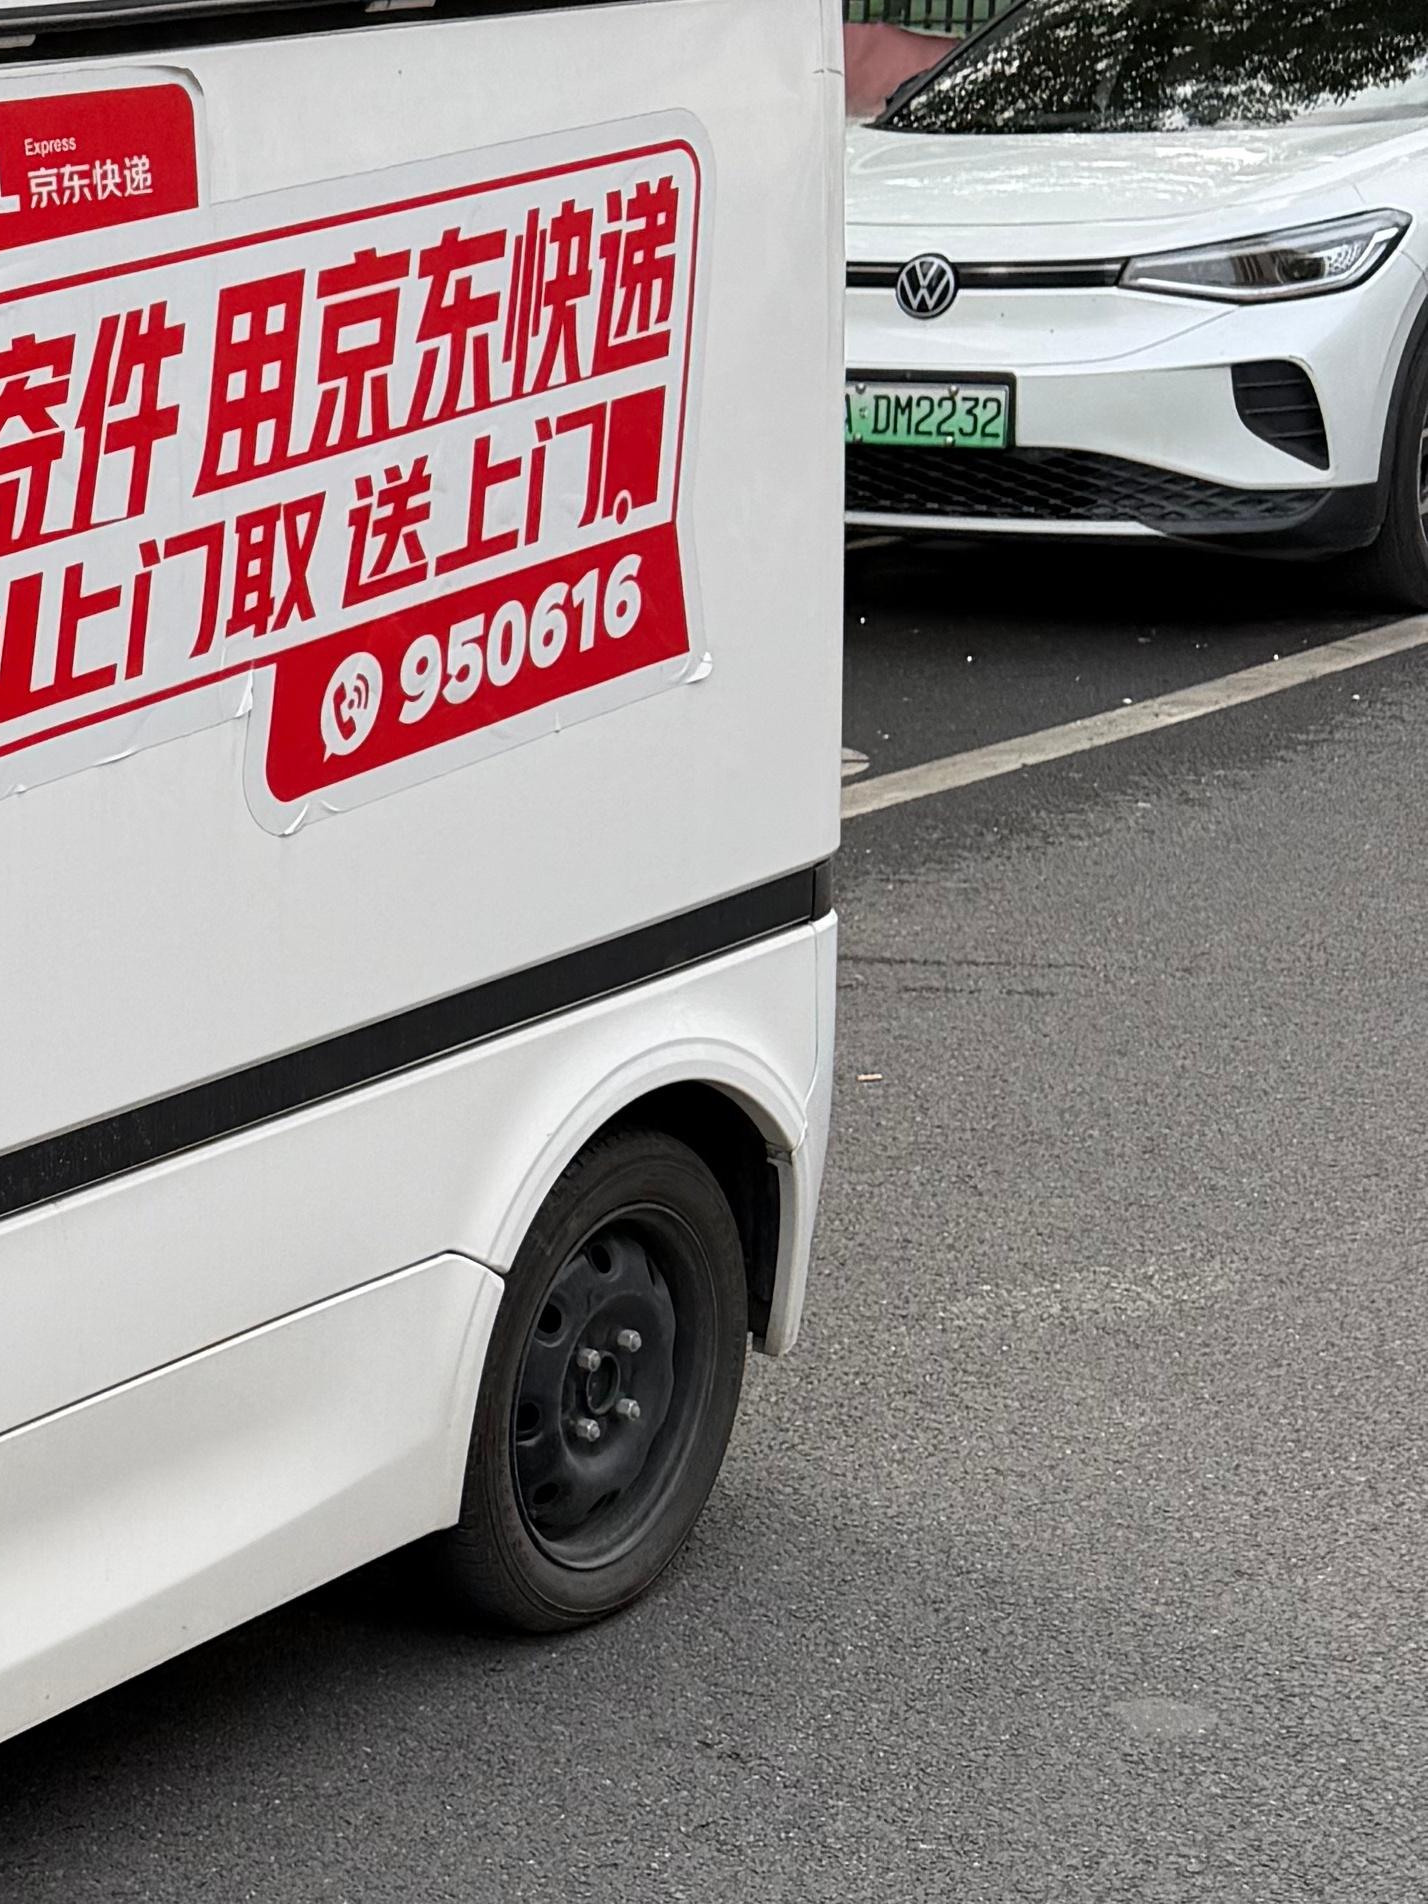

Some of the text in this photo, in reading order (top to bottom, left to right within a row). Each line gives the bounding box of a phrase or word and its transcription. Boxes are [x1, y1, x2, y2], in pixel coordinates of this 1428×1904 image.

[24, 135, 77, 156] Express
[29, 155, 154, 210] 京东快递
[399, 554, 643, 726] 950616
